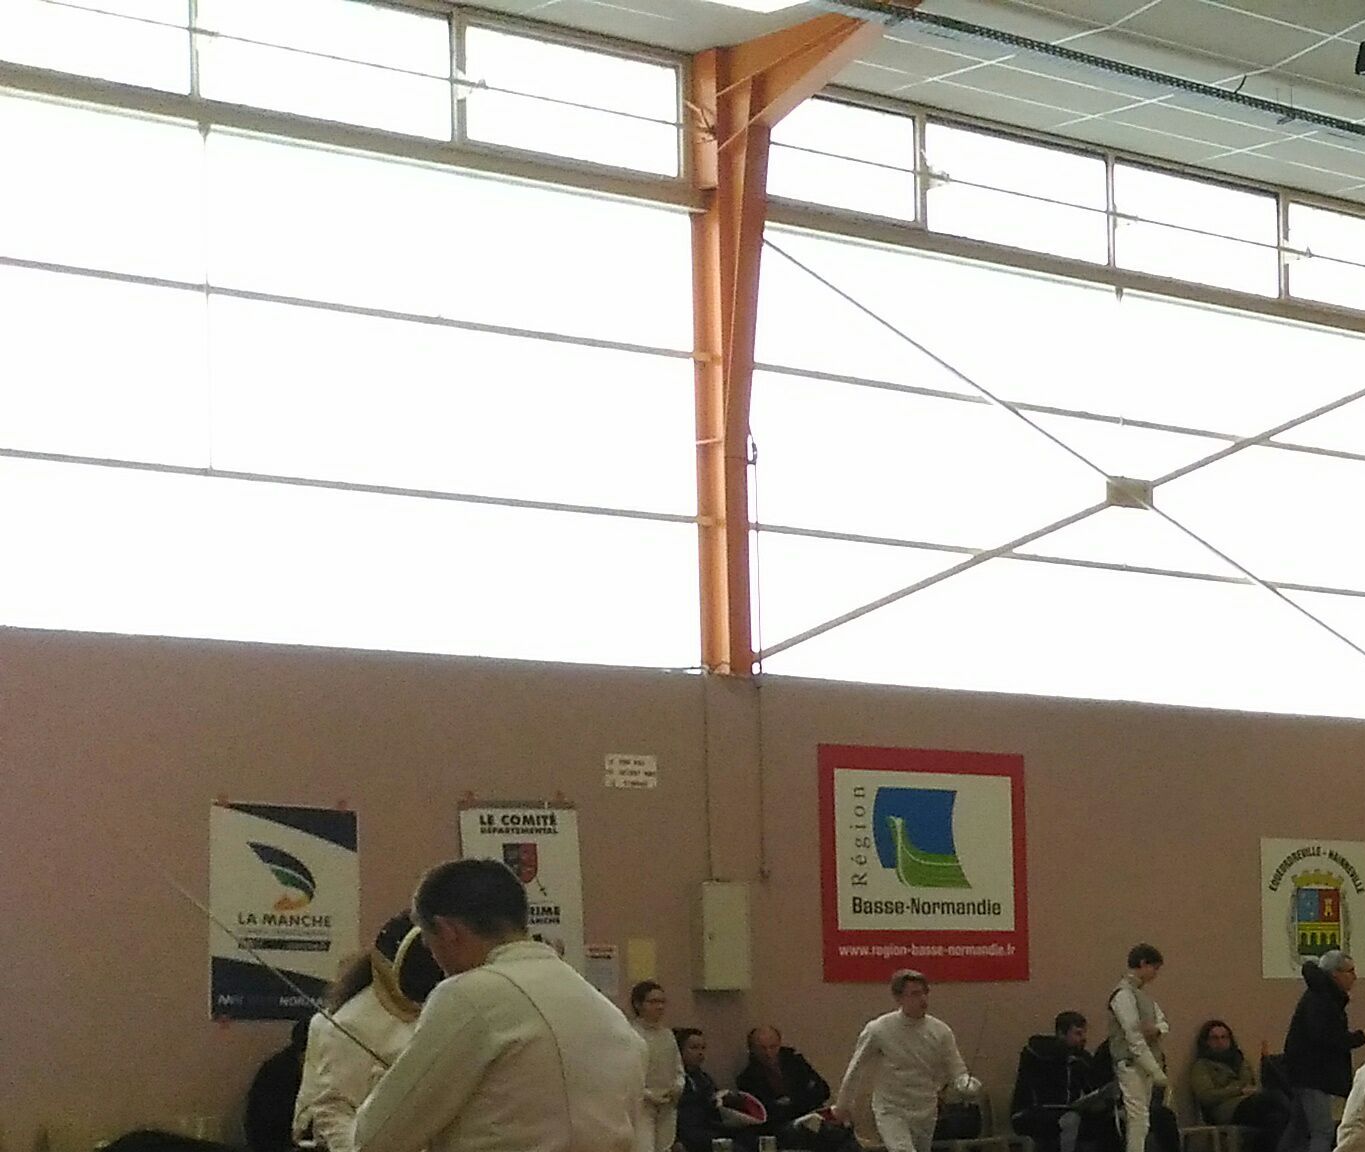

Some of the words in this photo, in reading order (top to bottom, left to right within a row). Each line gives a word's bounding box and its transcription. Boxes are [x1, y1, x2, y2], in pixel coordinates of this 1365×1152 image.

[479, 814, 494, 826] LE
[501, 812, 558, 826] COMITÉ
[850, 786, 871, 887] Région
[852, 896, 1001, 916] Basse-Normandie
[237, 911, 258, 925] LA
[263, 912, 332, 928] MANCHE
